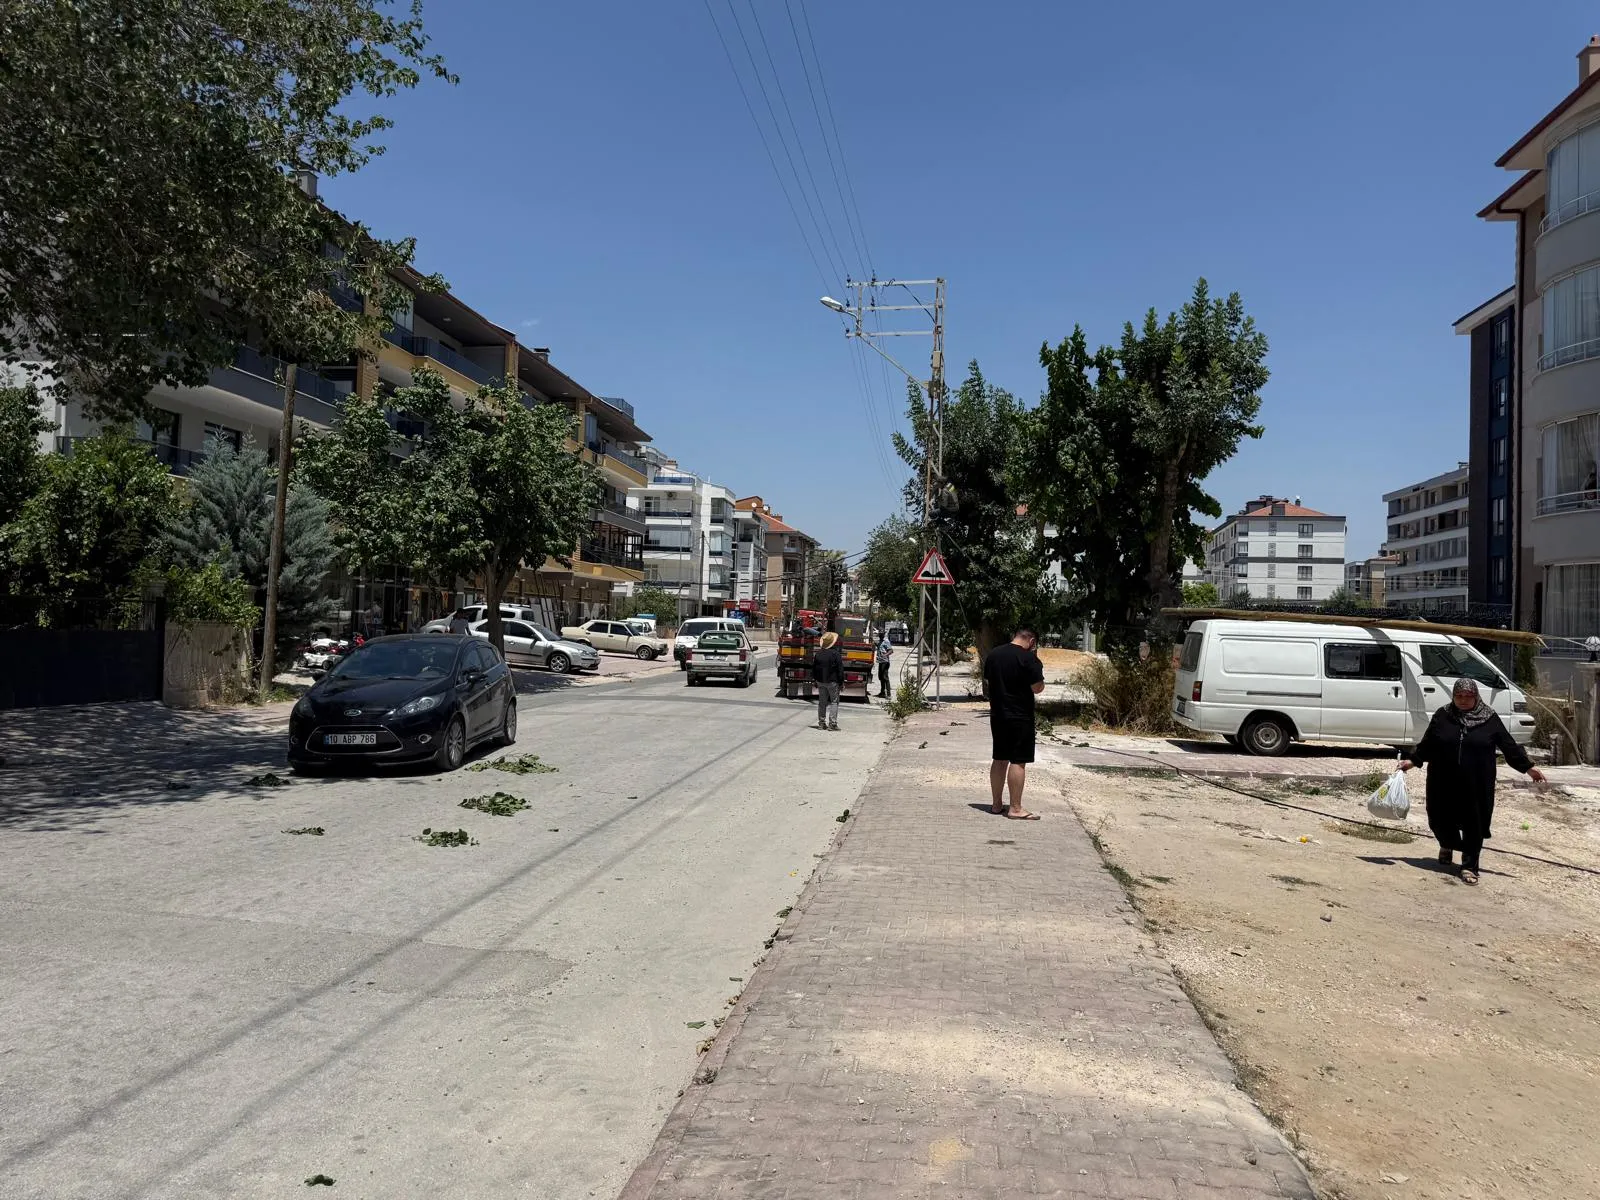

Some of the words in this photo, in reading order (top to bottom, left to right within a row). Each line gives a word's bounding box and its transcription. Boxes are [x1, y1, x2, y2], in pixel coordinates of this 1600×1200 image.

[329, 735, 338, 743] 10
[342, 735, 357, 743] ABP
[360, 735, 375, 743] 786
